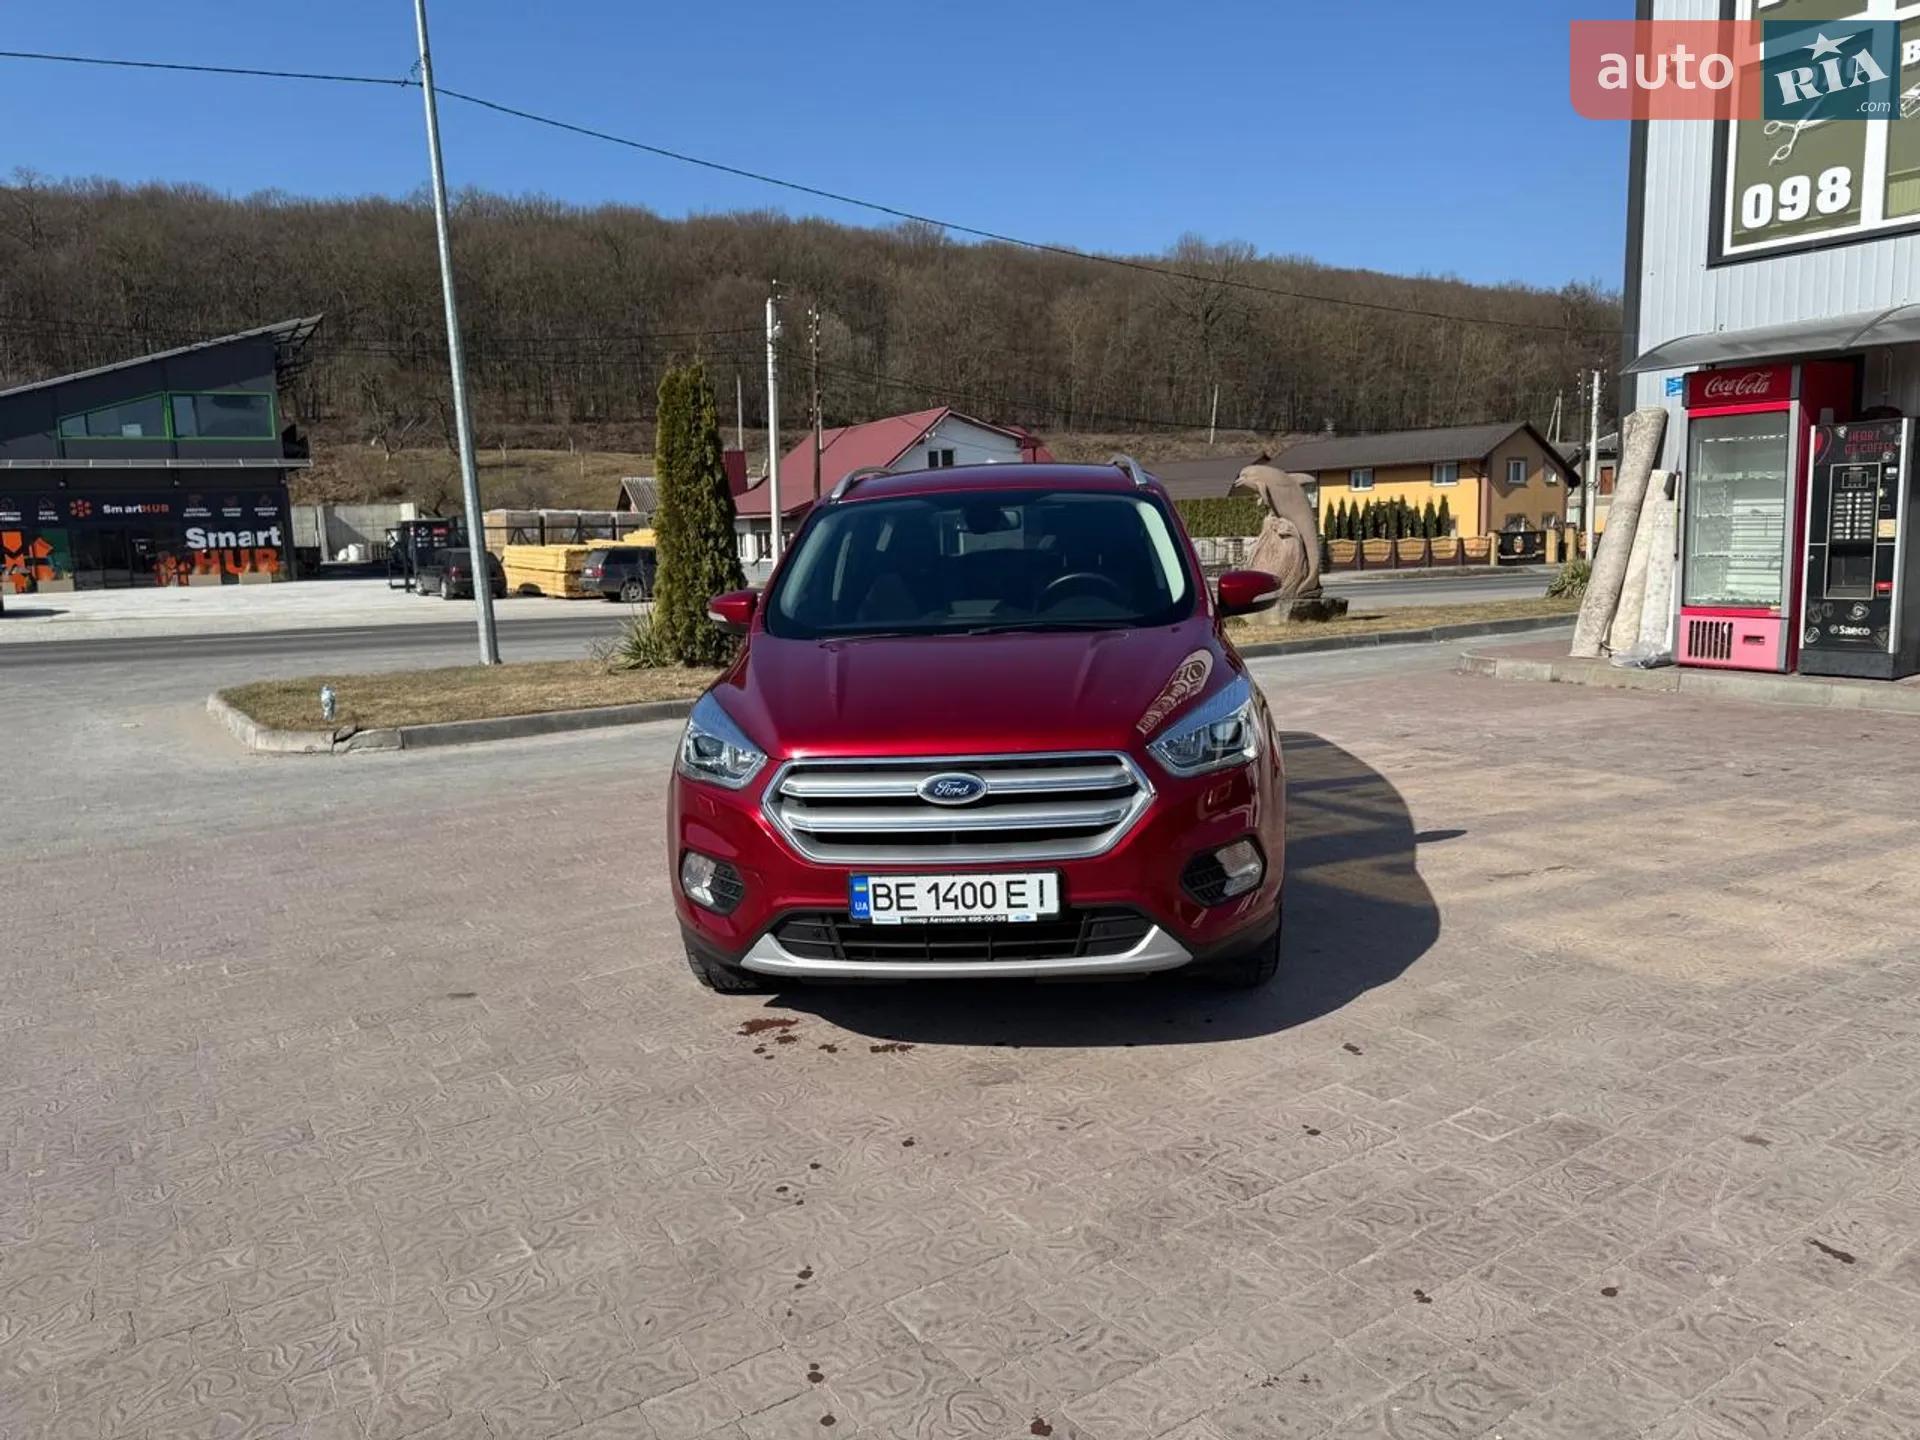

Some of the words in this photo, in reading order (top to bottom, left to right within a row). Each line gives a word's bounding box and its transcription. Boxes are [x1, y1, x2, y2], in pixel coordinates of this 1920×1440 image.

[1741, 166, 1852, 229] 098
[1704, 372, 1773, 398] Coca-Cola
[186, 526, 282, 549] Smart
[194, 548, 280, 575] HUB
[1839, 625, 1871, 636] Saeco
[934, 781, 969, 796] Ford
[854, 902, 869, 912] UA
[871, 882, 918, 912] BE
[926, 880, 997, 911] 1400
